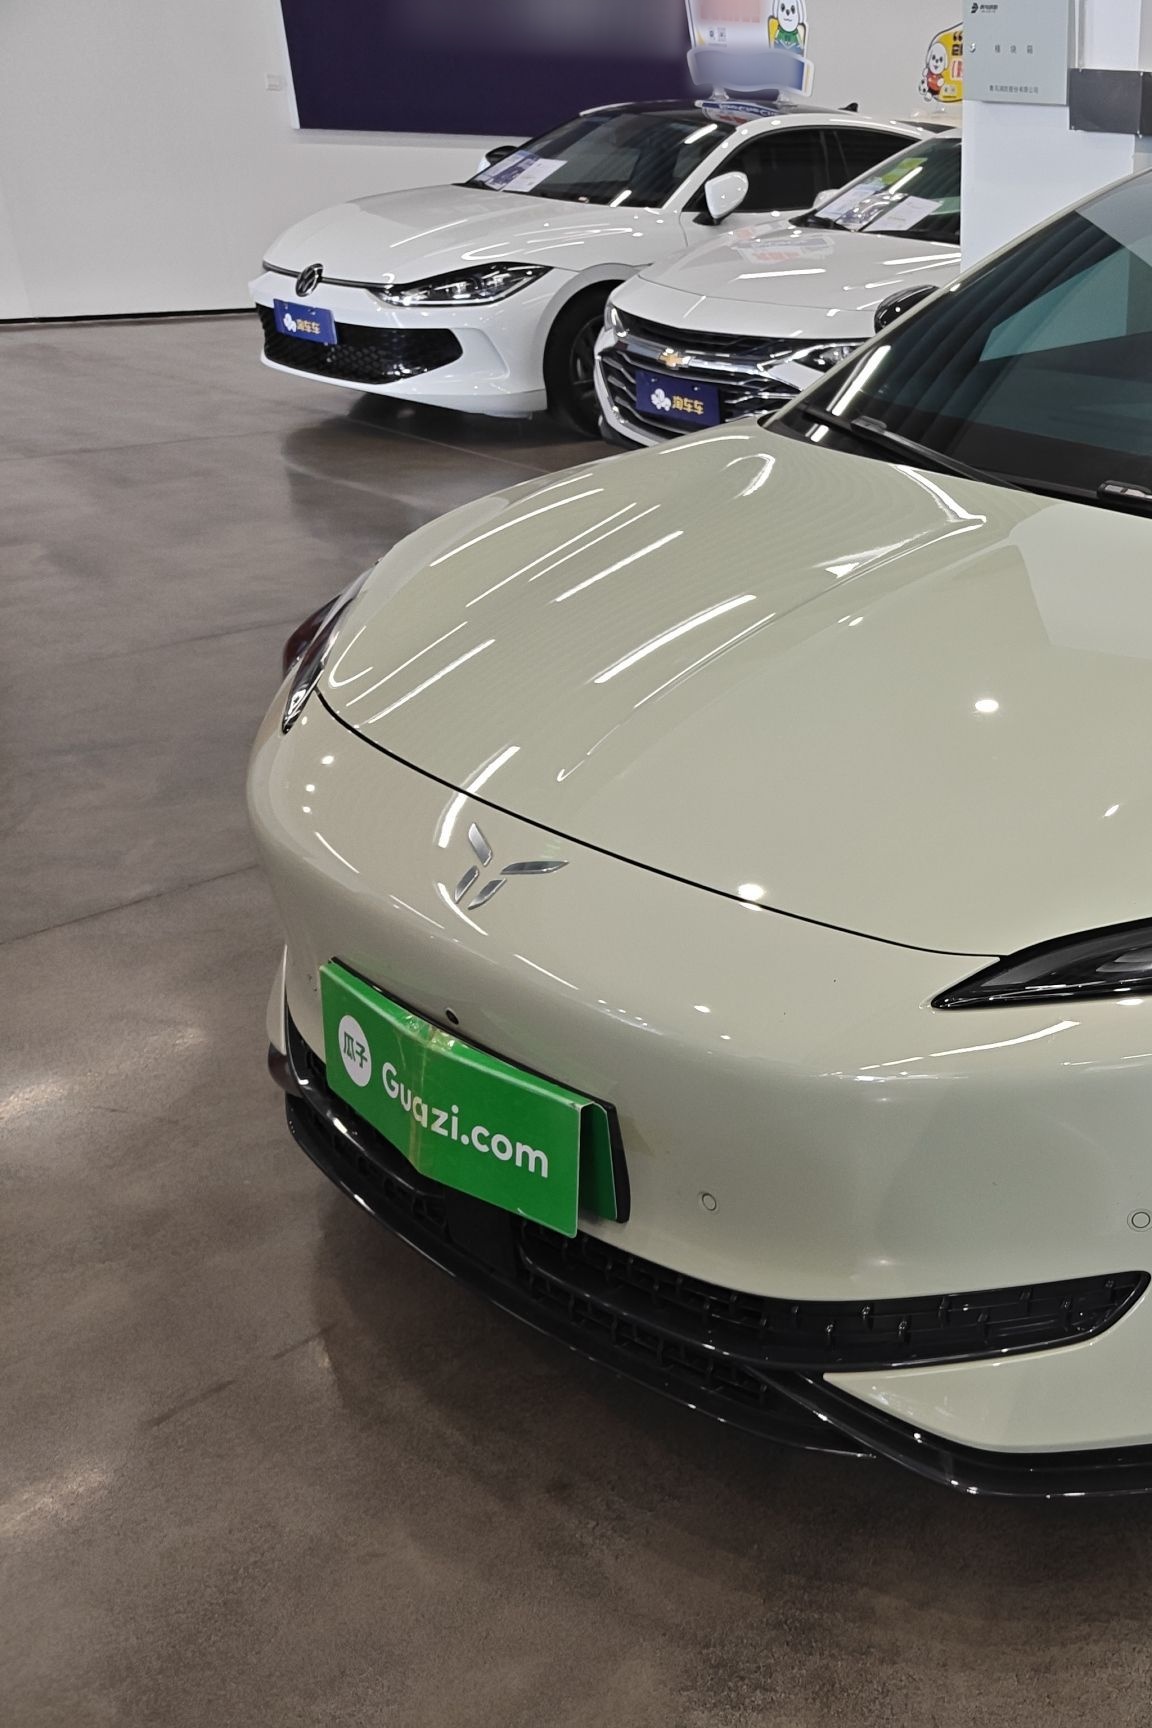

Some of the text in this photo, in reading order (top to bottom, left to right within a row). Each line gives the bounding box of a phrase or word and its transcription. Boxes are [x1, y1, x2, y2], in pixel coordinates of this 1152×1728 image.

[296, 319, 321, 334] 淘车车
[672, 395, 705, 415] 淘车车
[342, 1031, 369, 1069] 瓜子
[382, 1061, 550, 1179] Guazi.com
